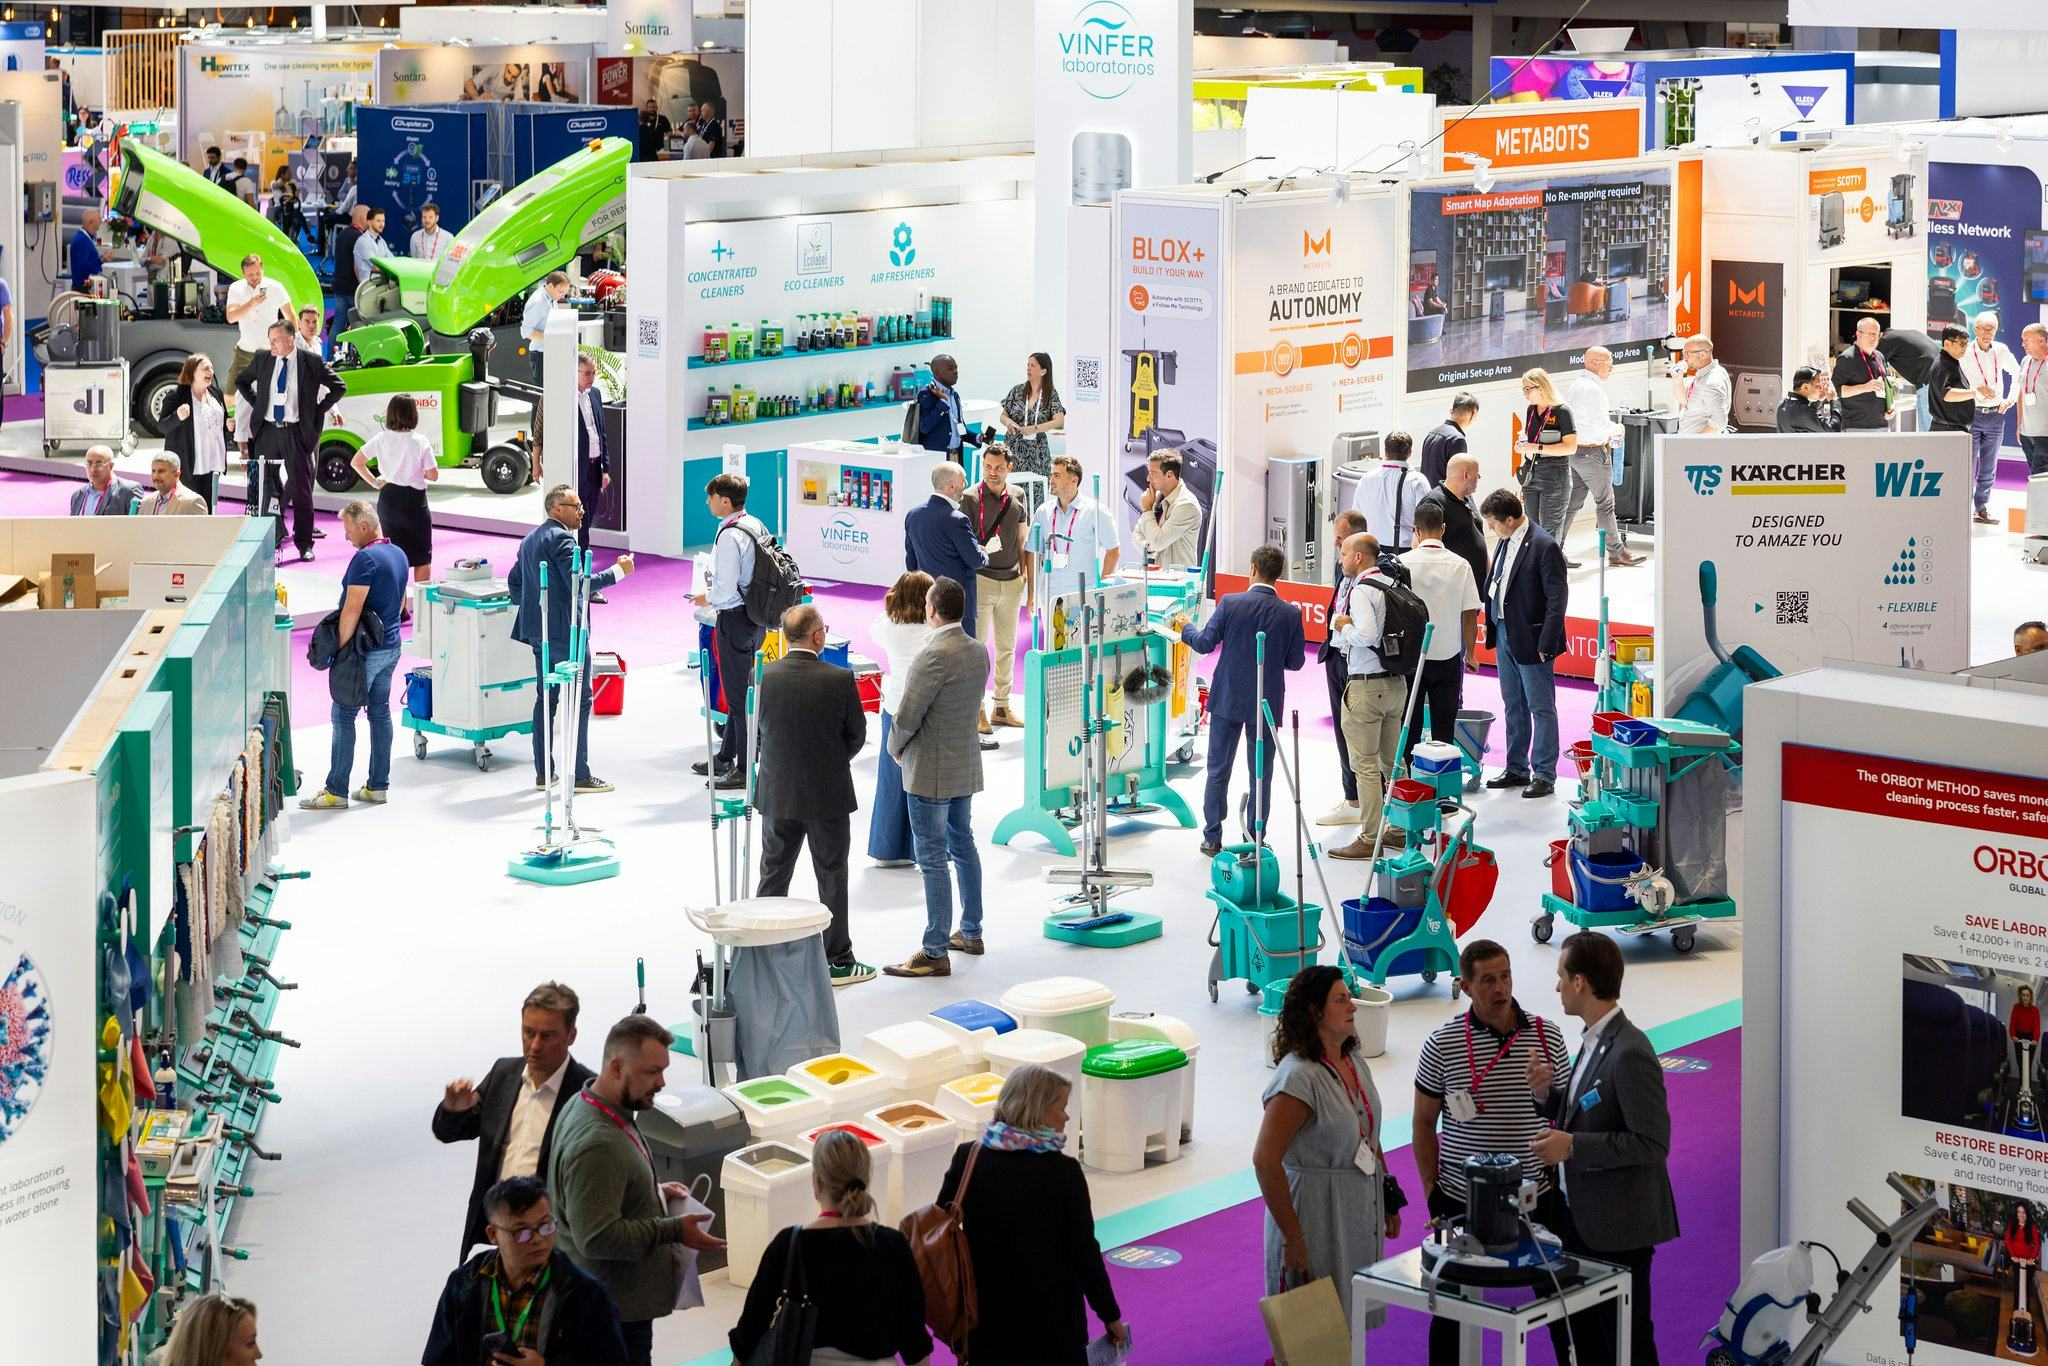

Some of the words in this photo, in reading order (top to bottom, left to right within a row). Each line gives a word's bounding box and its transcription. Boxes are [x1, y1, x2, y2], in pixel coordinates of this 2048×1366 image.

[624, 20, 670, 36] Sontara
[1058, 32, 1154, 58] VINFER
[292, 62, 319, 71] cleaning
[342, 60, 351, 69] for
[1062, 57, 1154, 76] laboratorios
[393, 71, 427, 84] Sontara
[1795, 95, 1815, 103] KLEEN
[1495, 123, 1590, 156] METABOTS
[30, 152, 48, 163] PRO
[1837, 174, 1863, 187] SCOTTY
[1545, 191, 1557, 202] No
[1558, 186, 1607, 202] Re-mapping
[1608, 183, 1642, 199] required
[1445, 198, 1472, 211] Smart
[1473, 197, 1492, 212] Map
[1493, 193, 1540, 209] Adaptation
[591, 213, 609, 228] FOR
[1957, 222, 2012, 239] Network
[1132, 236, 1206, 264] BLOX+
[687, 266, 758, 283] CONCENTRATED
[870, 272, 886, 284] AIR
[886, 268, 935, 281] FRESHENERS
[1132, 265, 1155, 275] BUILD
[1156, 267, 1163, 275] IT
[1164, 268, 1186, 278] YOUR
[1187, 270, 1205, 279] WAY
[700, 284, 745, 299] CLEANERS
[784, 279, 802, 292] ECO
[802, 275, 845, 290] CLEANERS
[1268, 285, 1275, 296] A
[1276, 282, 1306, 296] BRAND
[1307, 278, 1351, 293] DEDICATED
[1353, 276, 1364, 288] TO
[1178, 304, 1203, 312] Technology
[1269, 292, 1363, 322] AUTONOMY
[1728, 310, 1765, 318] METABOTS
[1677, 322, 1691, 333] OTS
[1624, 348, 1640, 357] Area
[1376, 374, 1384, 382] 45
[1438, 367, 1469, 383] Original
[1469, 365, 1494, 381] Set-up
[1494, 363, 1512, 376] Area
[1731, 463, 1846, 482] KÄRCHER
[1875, 458, 1944, 497] Wiz
[1752, 514, 1825, 529] DESIGNED
[820, 526, 869, 544] VINFER
[1735, 534, 1754, 548] TO
[1757, 533, 1807, 548] AMAZE
[1811, 533, 1842, 547] YOU
[822, 541, 870, 554] laboratorios
[1887, 602, 1938, 612] FLEXIBLE
[1882, 621, 1888, 629] 4
[1910, 623, 1931, 631] wringing
[1857, 769, 1879, 783] The
[1880, 772, 1924, 789] ORBOT
[1926, 778, 1981, 797] METHOD
[1983, 789, 2016, 802] saves
[1885, 790, 1934, 810] cleaning
[1936, 800, 1980, 814] process
[1982, 803, 2020, 820] faster,
[2009, 883, 2047, 897] GLOBAL
[1965, 914, 1999, 930] SAVE
[2002, 920, 2048, 938] LABOR
[1933, 925, 1958, 939] Save
[1960, 931, 1967, 941] €
[1969, 932, 2011, 947] 42.000+
[2013, 938, 2023, 949] in
[1959, 945, 1964, 954] 1
[1965, 947, 2016, 964] employee
[2017, 957, 2032, 966] vs.
[2035, 957, 2042, 967] 2
[1935, 1131, 1996, 1154] RESTORE
[1924, 1145, 1949, 1160] Save
[1951, 1151, 1958, 1161] €
[1999, 1161, 2016, 1173] per
[2018, 1166, 2041, 1179] year
[9, 1165, 65, 1193] laboratories
[1953, 1167, 1974, 1181] and
[1976, 1172, 2024, 1193] restoring
[16, 1194, 25, 1206] in
[27, 1178, 70, 1201] removing
[5, 1208, 32, 1225] water
[33, 1197, 59, 1214] alone
[1865, 1352, 1887, 1365] Data
